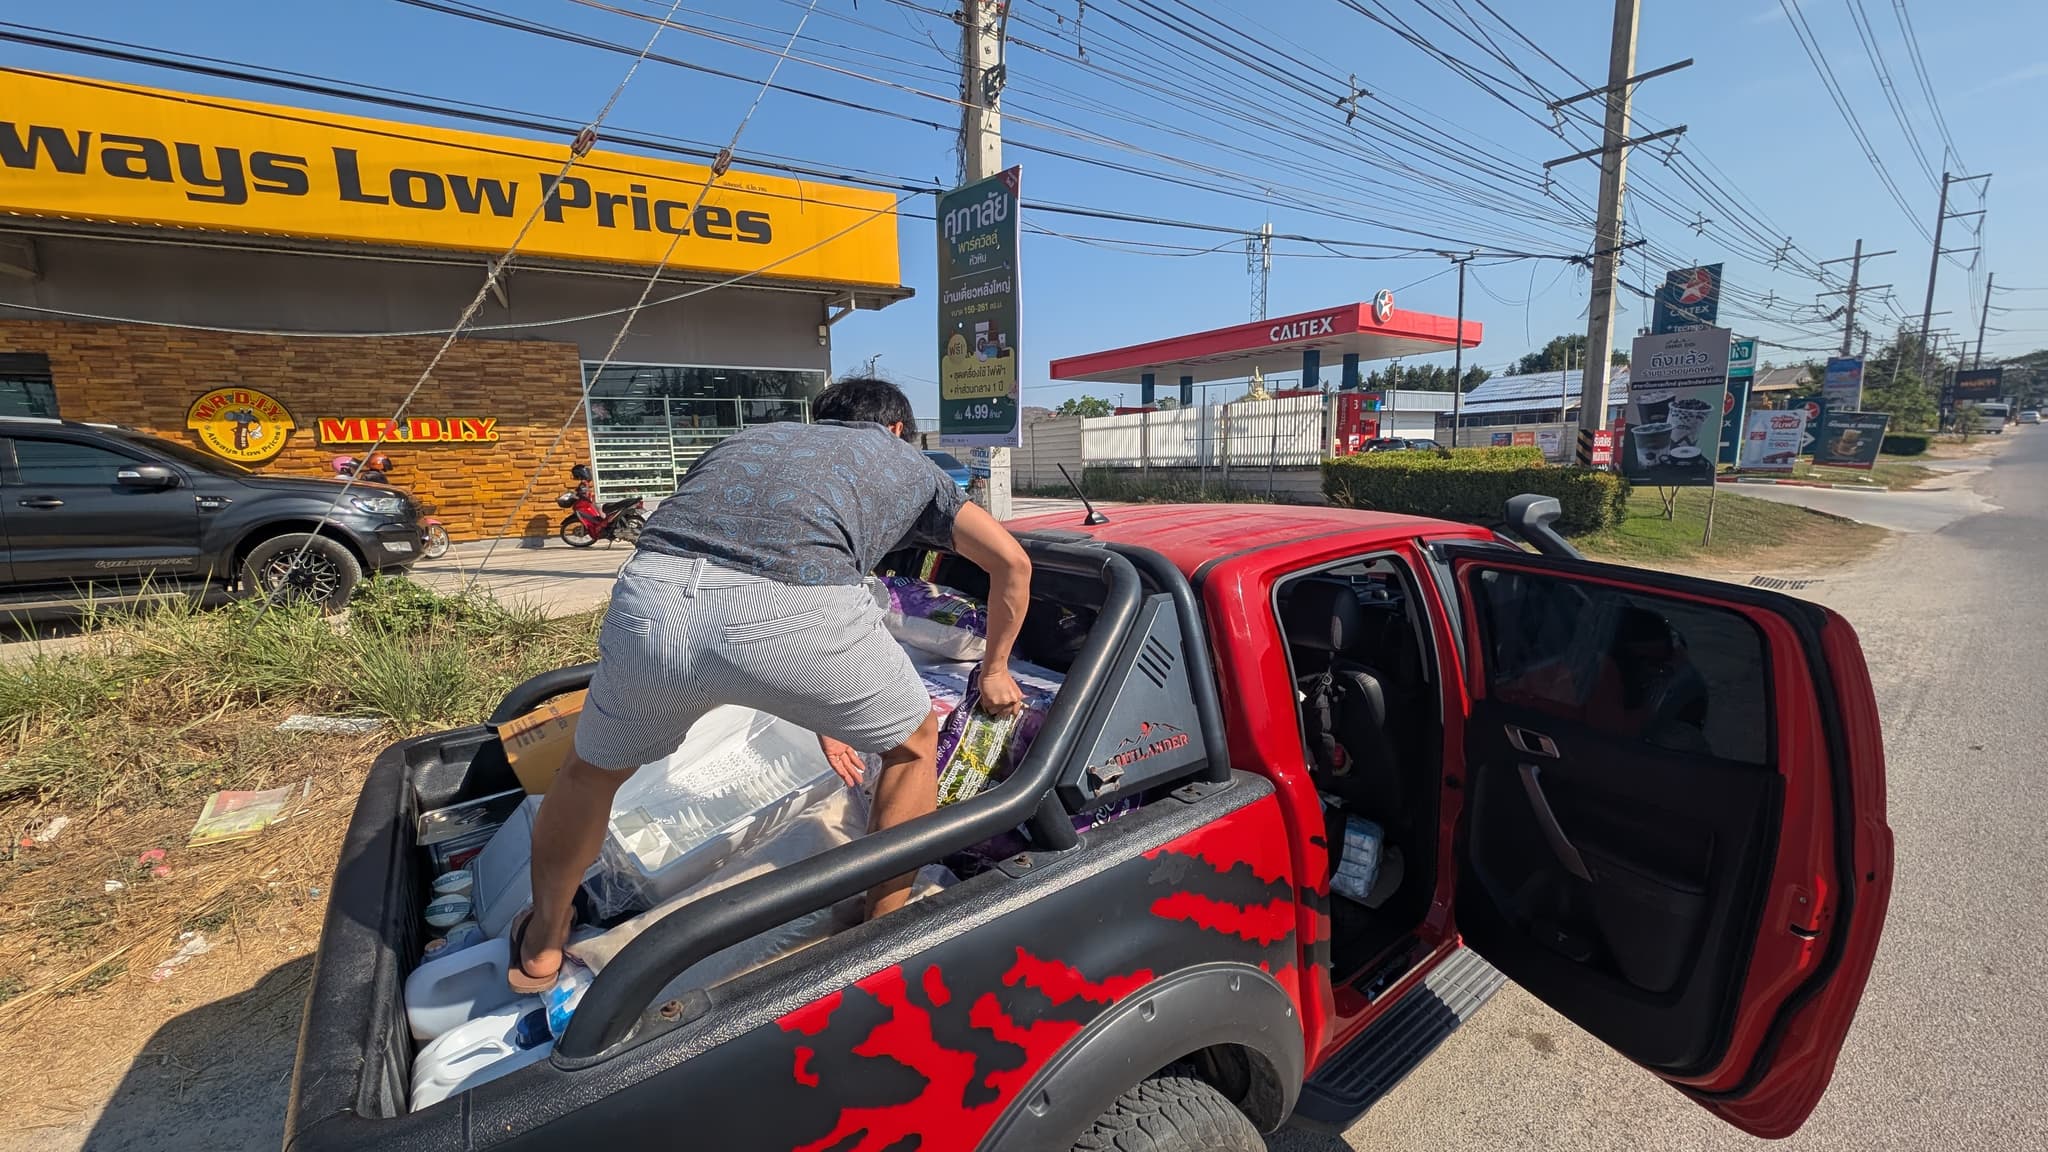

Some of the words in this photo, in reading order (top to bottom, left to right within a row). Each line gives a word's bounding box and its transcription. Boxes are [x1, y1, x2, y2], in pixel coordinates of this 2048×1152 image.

[0, 121, 310, 205] ways
[332, 147, 517, 217] Low
[540, 172, 772, 245] Prices
[944, 192, 1009, 244] ศุภาลัย
[943, 276, 1011, 304] บ้านเดี่ยวหลังใหญ่
[1670, 304, 1710, 317] CTEX
[1269, 316, 1334, 342] CALTEX
[1651, 350, 1709, 368] ถึงแล้ว
[194, 393, 227, 422] MR
[964, 404, 989, 420] 4.99
[206, 432, 238, 455] Always
[262, 431, 281, 452] Prices
[319, 417, 400, 443] MR
